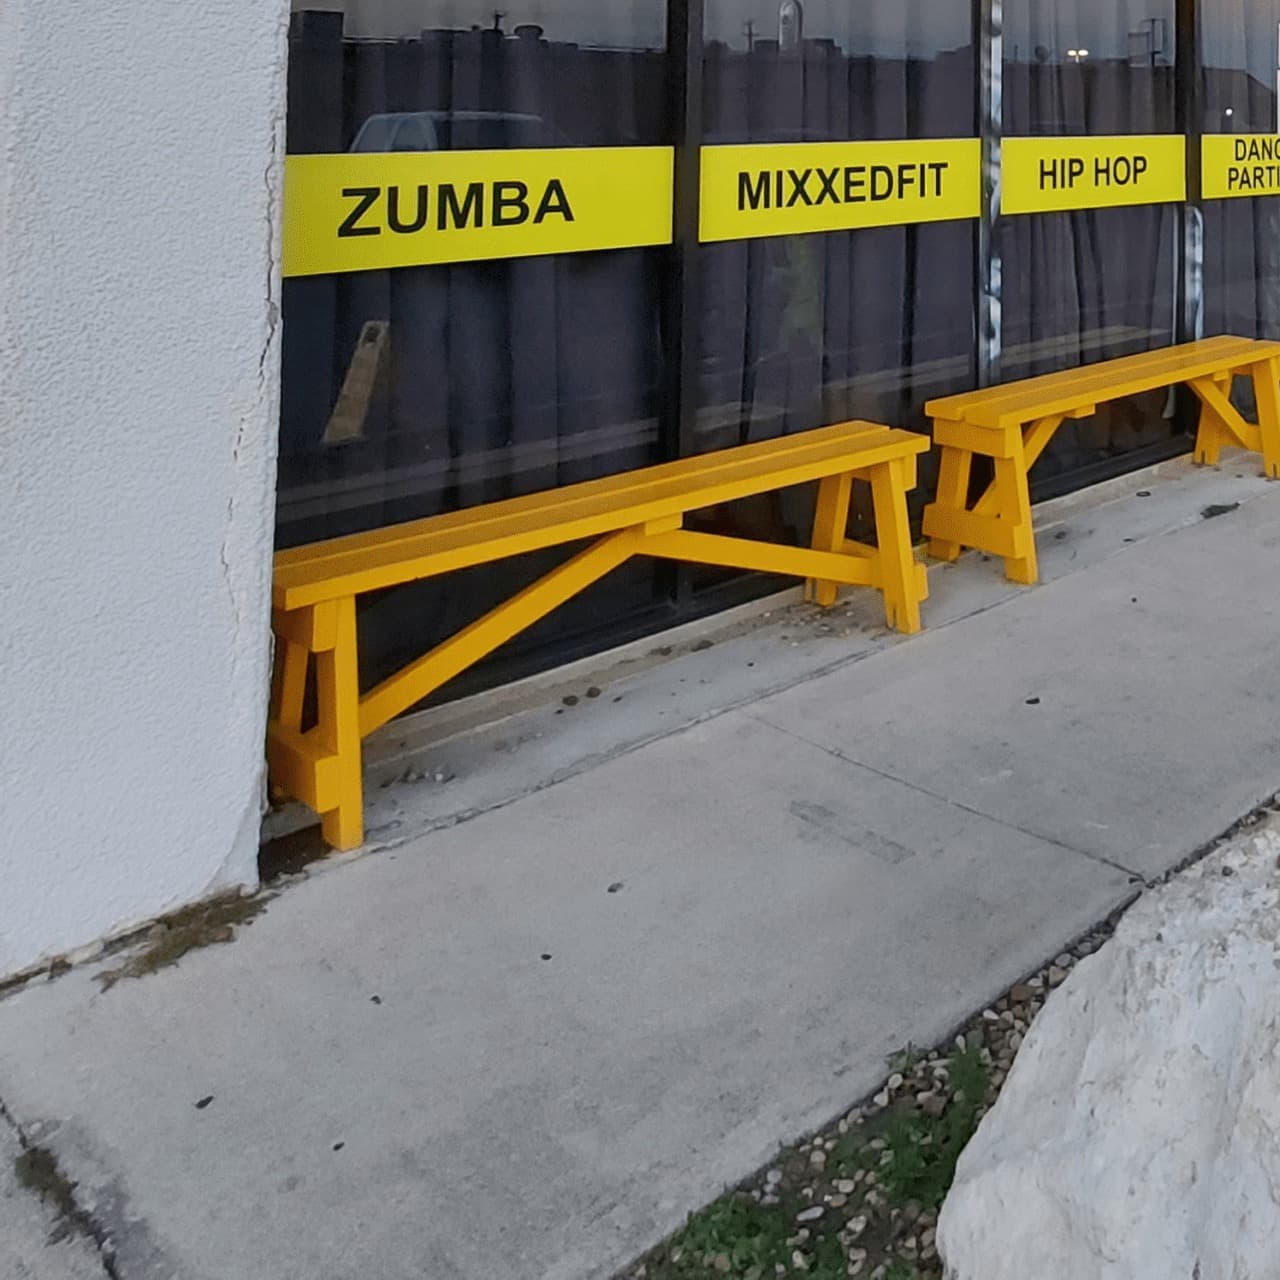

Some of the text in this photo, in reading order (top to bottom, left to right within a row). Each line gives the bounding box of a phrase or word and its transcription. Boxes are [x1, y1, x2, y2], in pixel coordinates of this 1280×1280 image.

[737, 161, 949, 210] MIXXEDFIT
[1039, 156, 1148, 190] HIP HOP
[336, 178, 575, 238] ZUMBA
